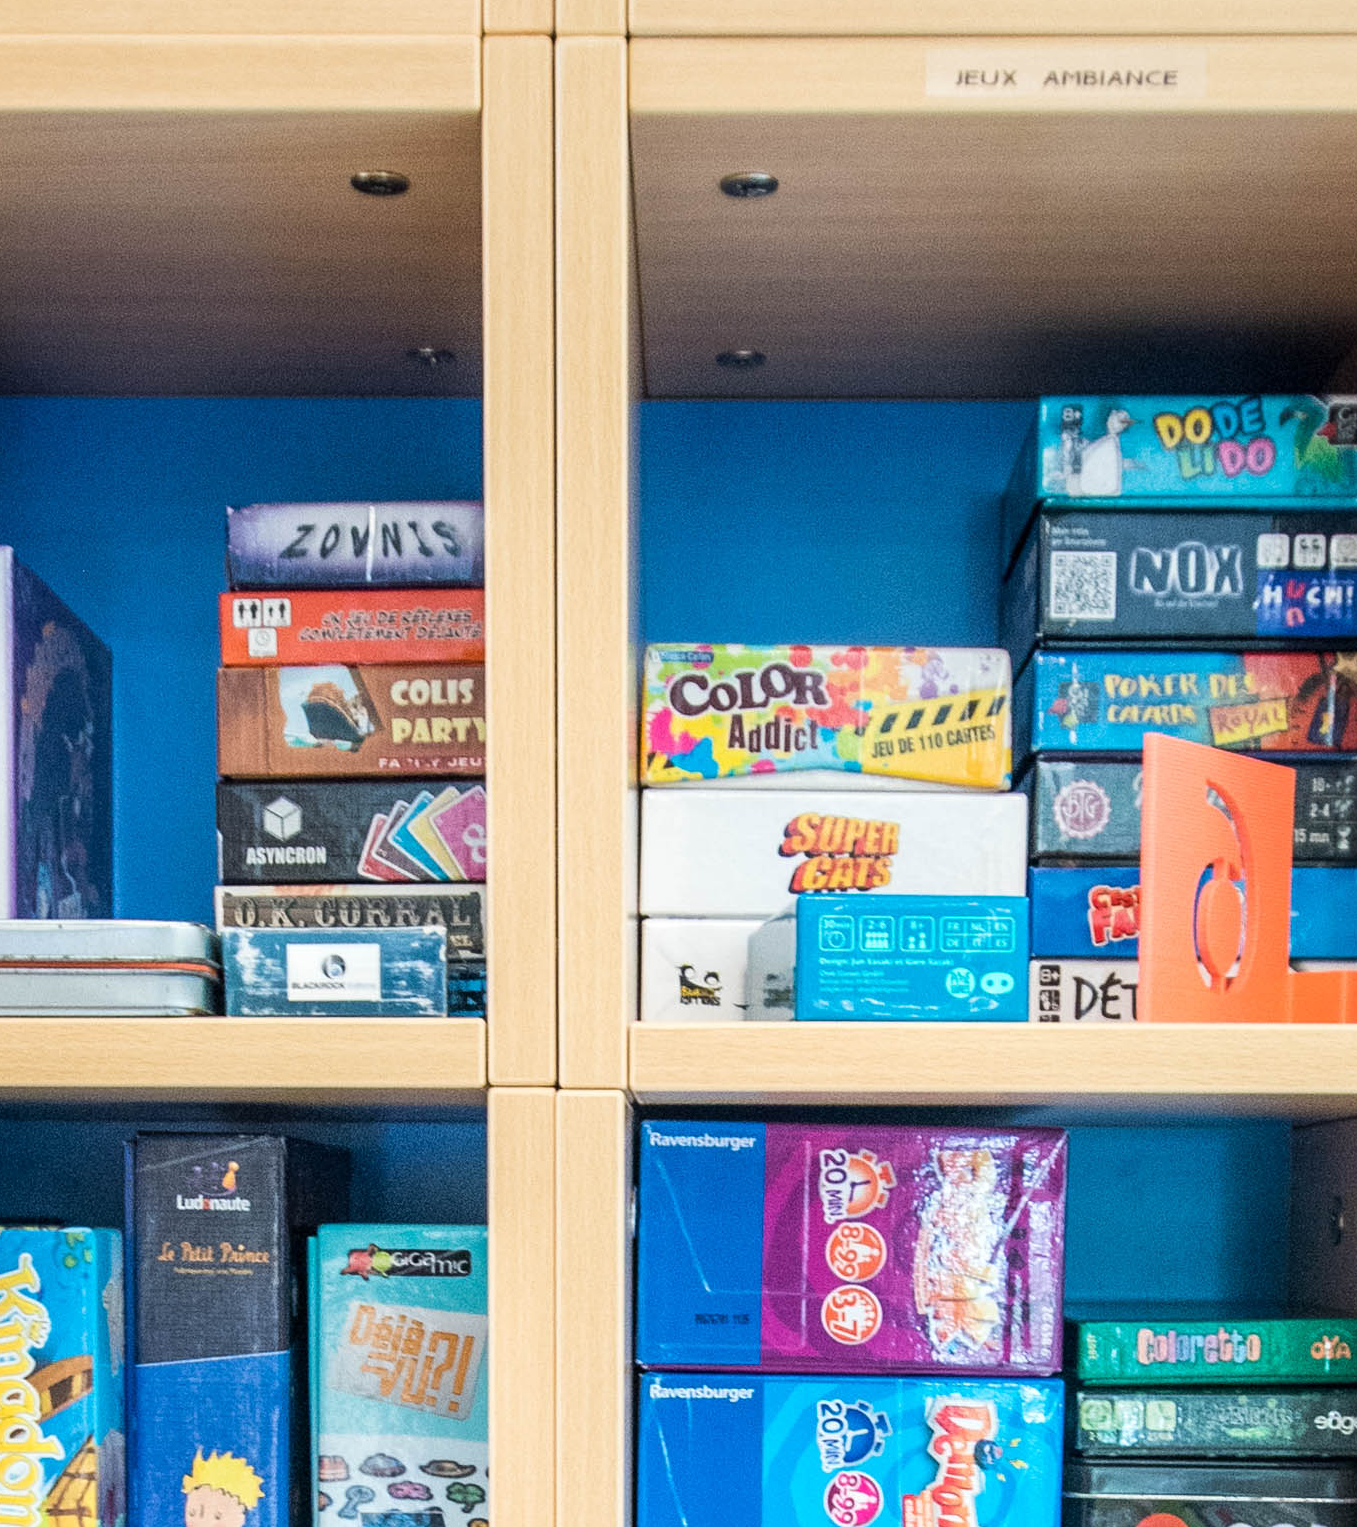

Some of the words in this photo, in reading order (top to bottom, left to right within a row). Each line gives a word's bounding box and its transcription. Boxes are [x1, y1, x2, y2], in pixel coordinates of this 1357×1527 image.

[955, 69, 1019, 87] JEUX
[1042, 69, 1180, 87] AMBIANCE
[1130, 541, 1243, 596] NOX
[390, 678, 474, 706] COLIS
[728, 714, 818, 754] Addict
[871, 738, 894, 759] JEU
[898, 737, 915, 755] DE
[919, 733, 943, 752] 110
[946, 725, 996, 748] CARTES
[780, 811, 900, 858] SUPER
[246, 846, 326, 865] ASYNCRON
[648, 1130, 757, 1153] Ravensburger
[157, 1240, 176, 1264] Le
[178, 1241, 215, 1264] Petit
[219, 1242, 271, 1266] Prince
[1137, 1329, 1262, 1365] Coloretto
[648, 1381, 755, 1404] Ravensburger
